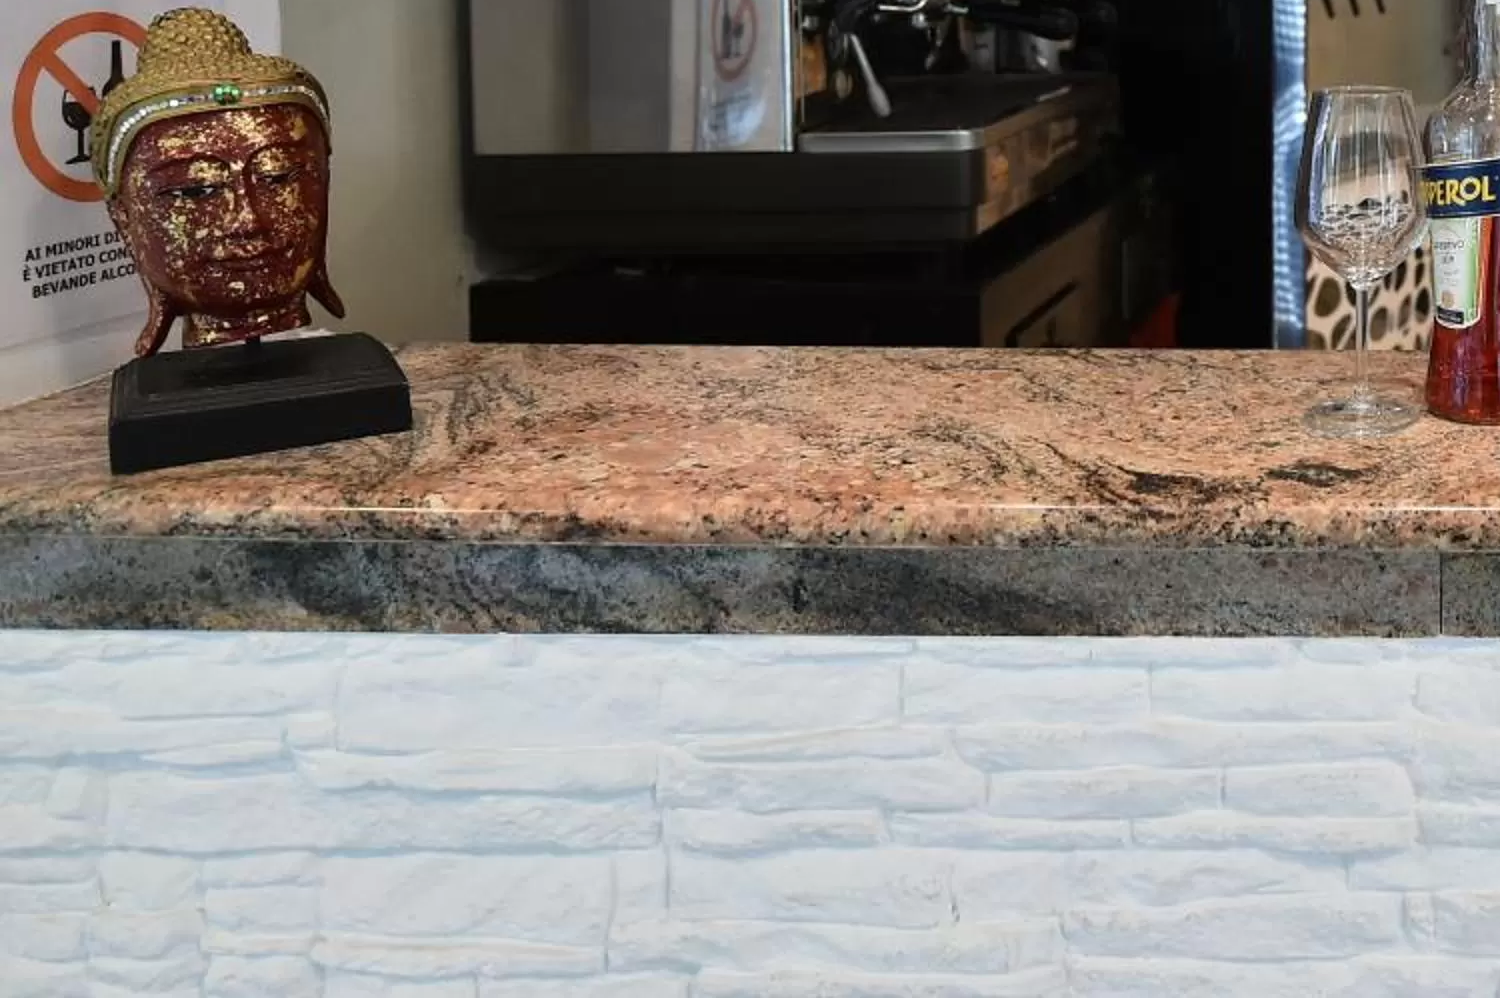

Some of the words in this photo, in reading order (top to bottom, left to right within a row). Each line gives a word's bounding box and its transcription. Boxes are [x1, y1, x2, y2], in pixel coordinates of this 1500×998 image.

[25, 247, 41, 262] AI
[45, 233, 101, 258] MINORI
[104, 230, 120, 245] DI
[22, 263, 32, 282] È
[35, 254, 95, 279] VIETATO
[99, 247, 133, 263] CON
[32, 271, 97, 299] BEVANDE
